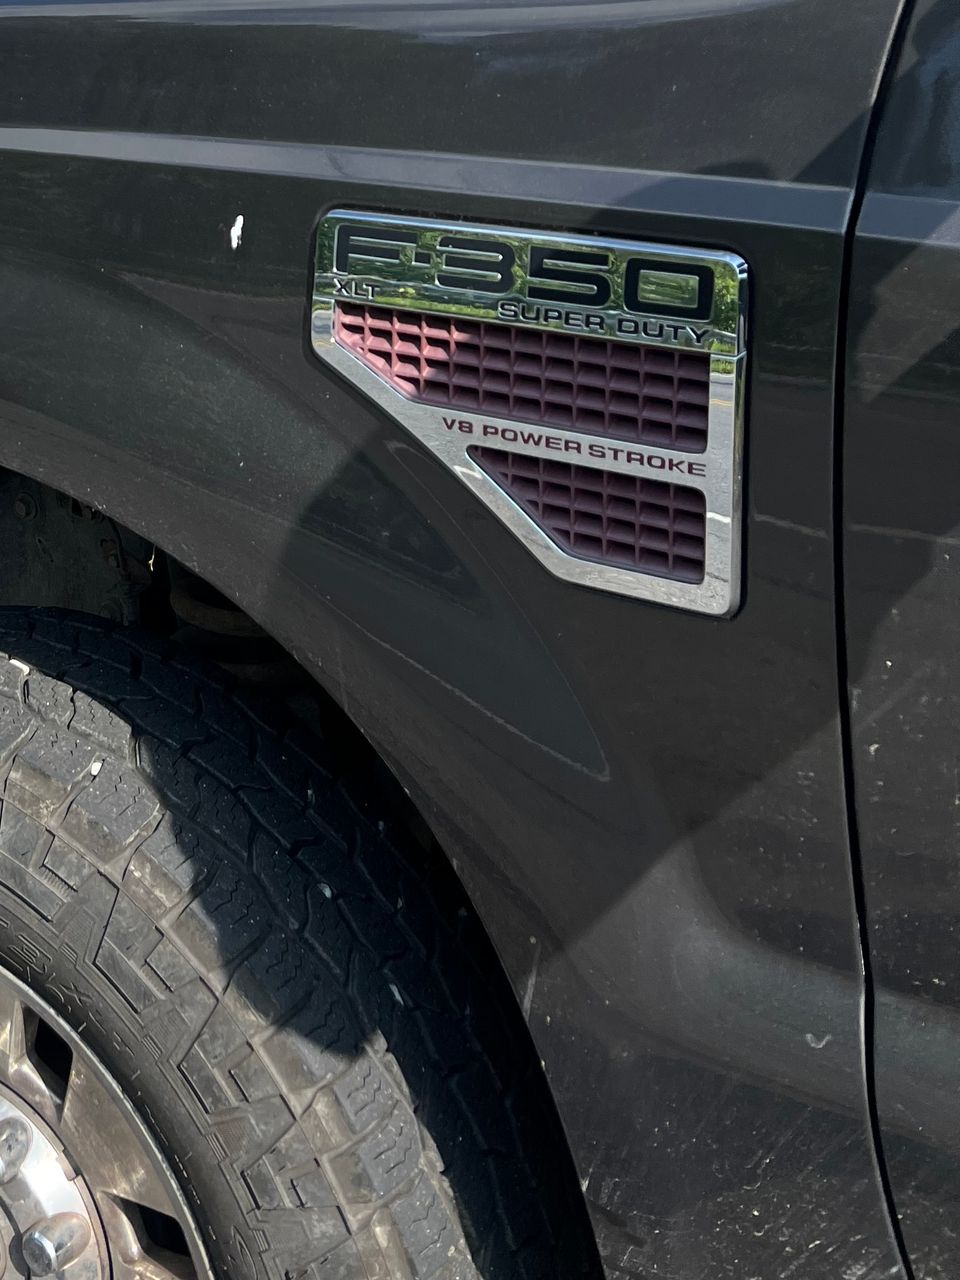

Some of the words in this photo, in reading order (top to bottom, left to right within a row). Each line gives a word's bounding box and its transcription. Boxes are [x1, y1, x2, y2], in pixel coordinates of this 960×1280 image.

[333, 277, 380, 300] XLT
[497, 300, 606, 333] SUPER
[616, 317, 712, 344] DUTY
[441, 417, 474, 435] V8
[483, 424, 583, 455] POWER
[588, 442, 707, 477] STROKE
